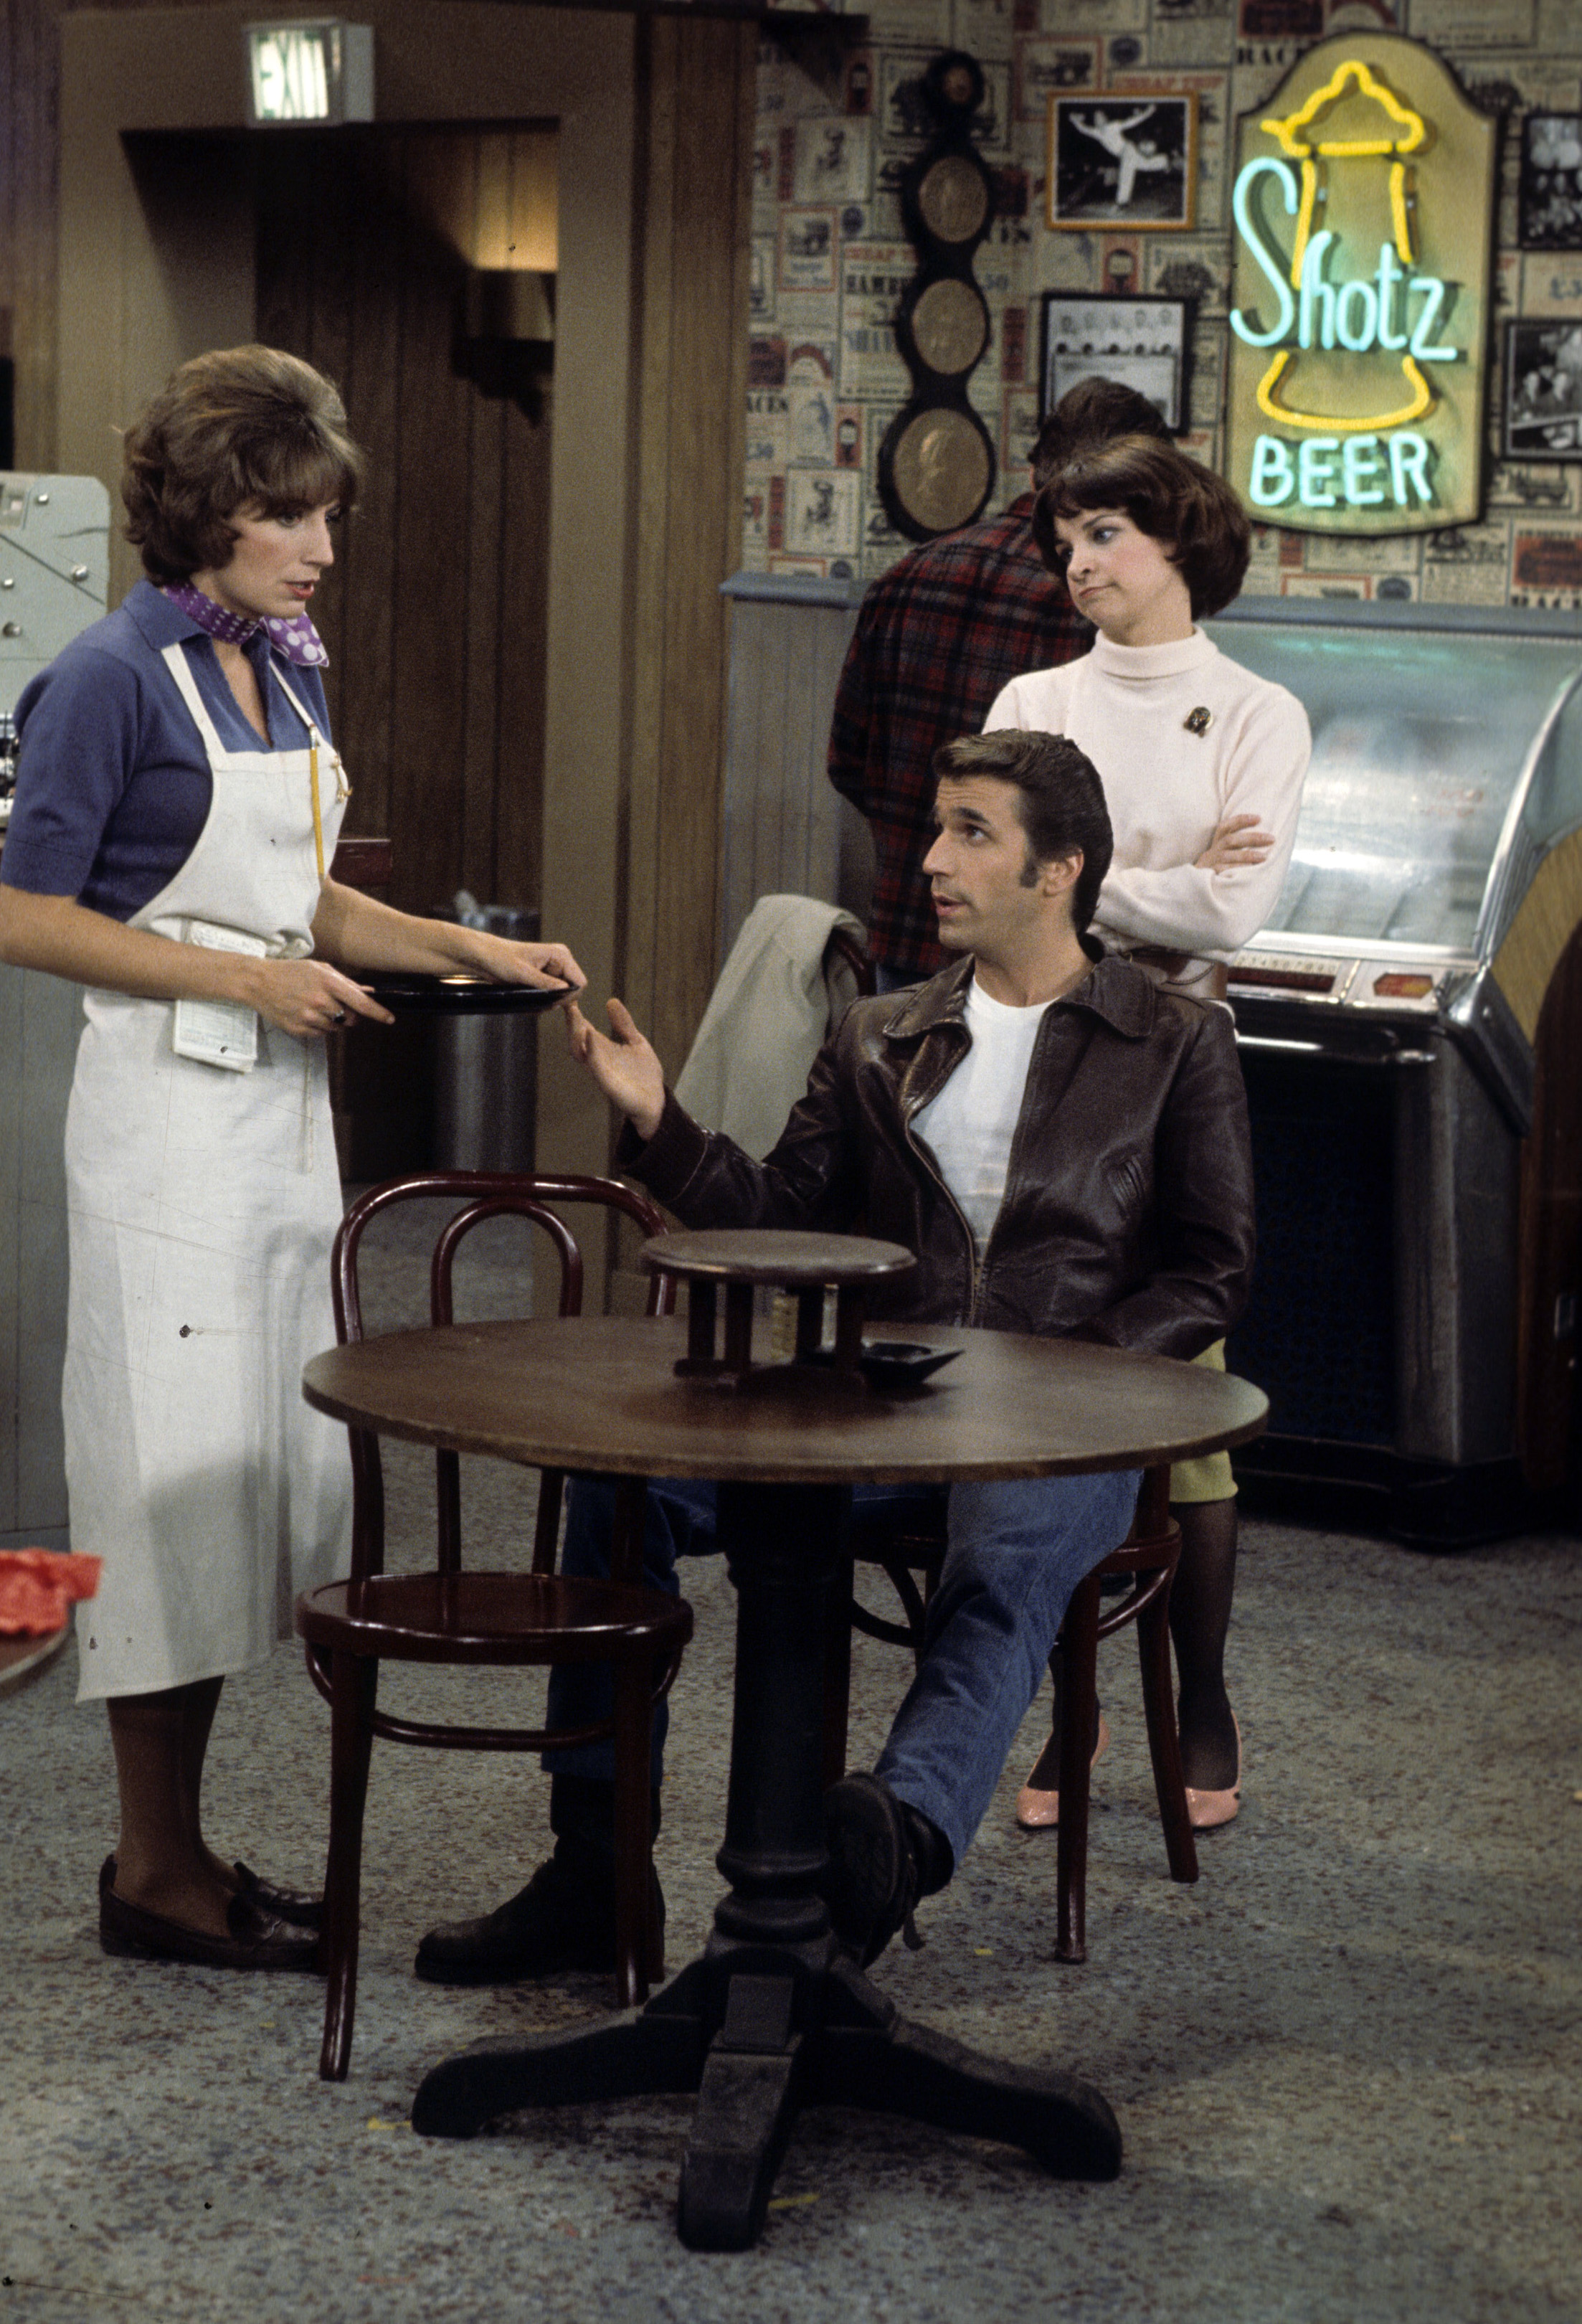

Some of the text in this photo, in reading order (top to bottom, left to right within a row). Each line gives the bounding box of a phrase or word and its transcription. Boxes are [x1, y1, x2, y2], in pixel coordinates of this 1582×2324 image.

[254, 32, 323, 120] EXIT
[1229, 156, 1457, 360] Shotz
[1249, 432, 1432, 506] BEER
